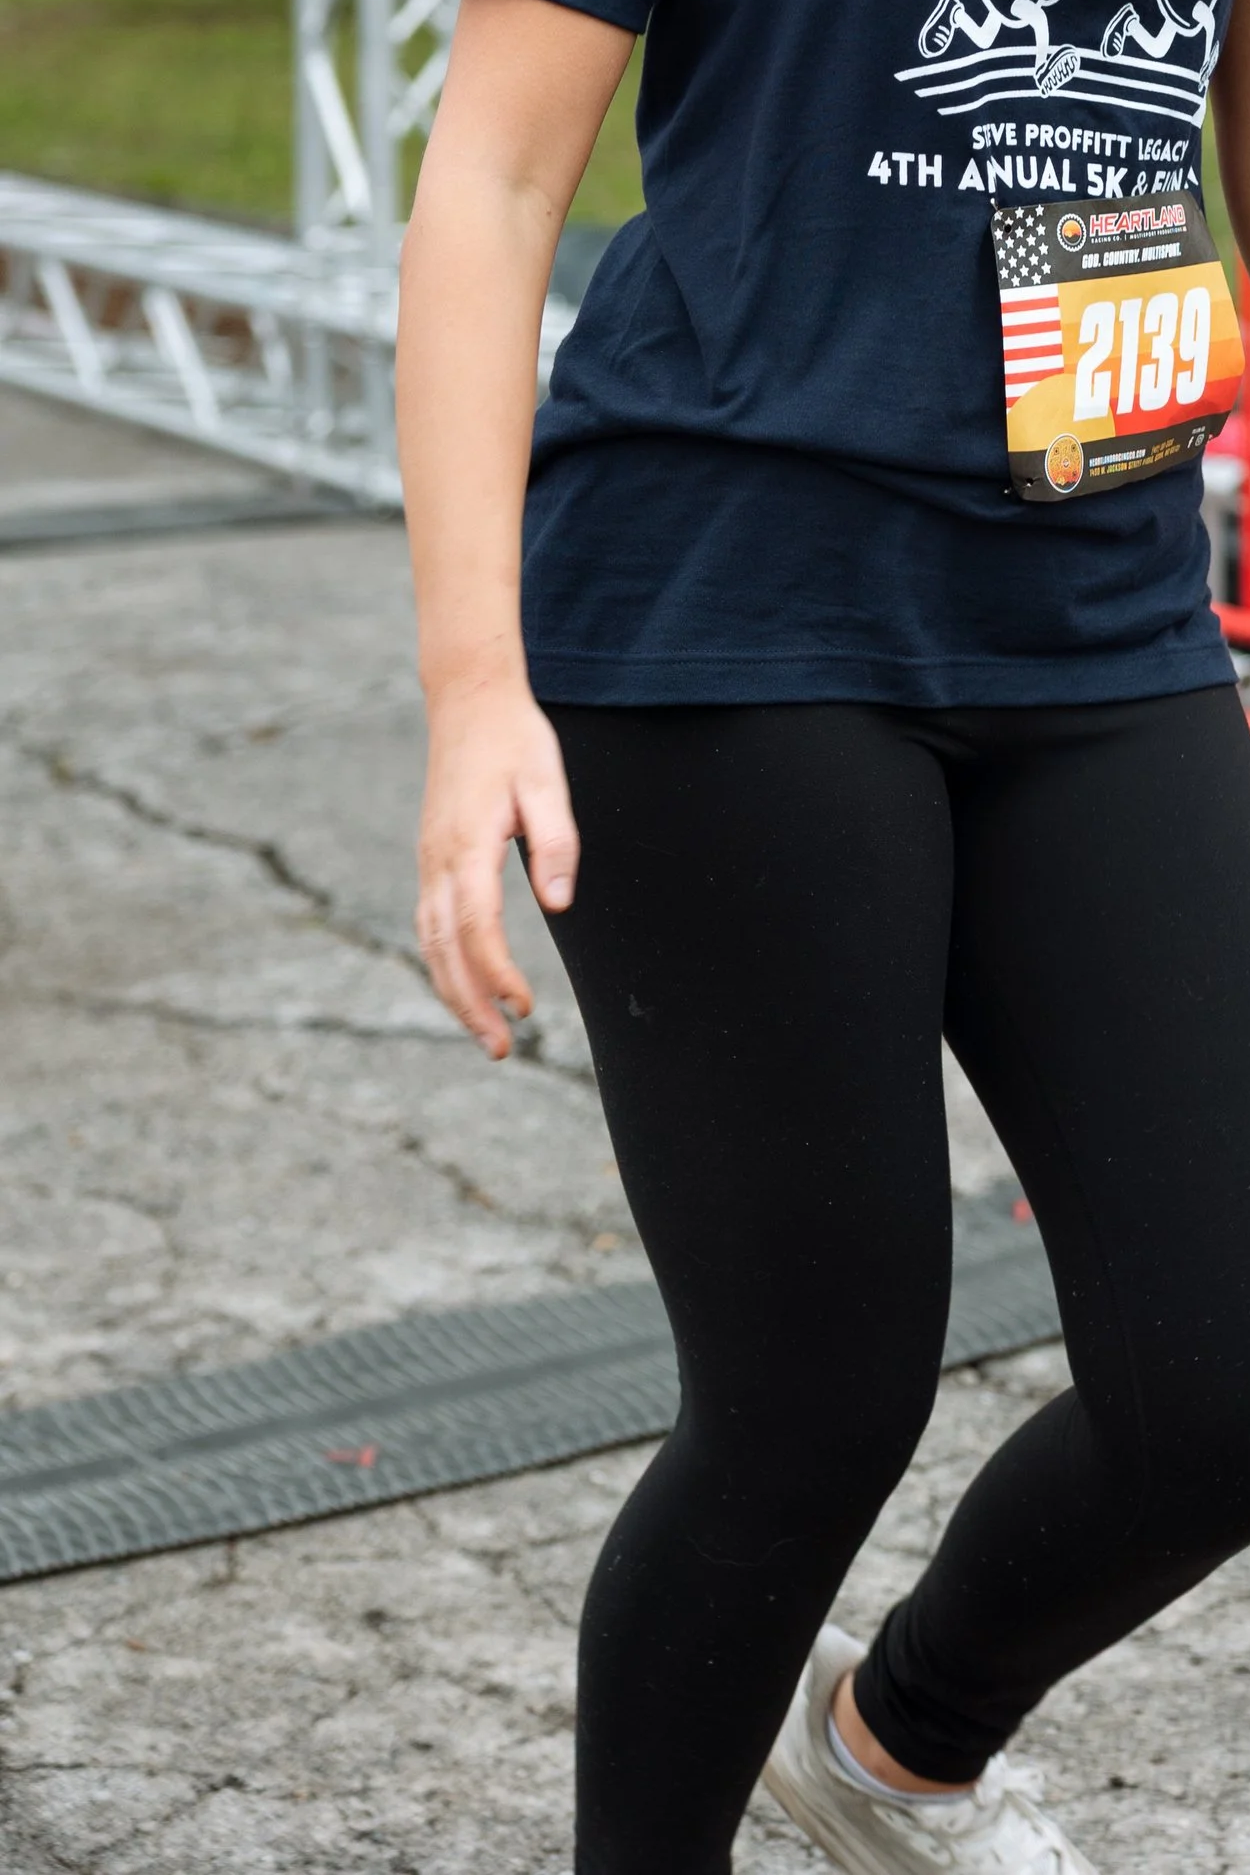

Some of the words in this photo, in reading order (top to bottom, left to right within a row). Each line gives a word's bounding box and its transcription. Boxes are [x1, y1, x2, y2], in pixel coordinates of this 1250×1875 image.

[1025, 123, 1132, 159] PROFFITT
[1138, 137, 1190, 162] LEGACY
[867, 151, 943, 188] 4TH
[1086, 162, 1128, 199] 5K
[1131, 170, 1149, 197] &
[1089, 204, 1187, 238] HEARTLAND
[1082, 252, 1101, 270] GOD.
[1103, 248, 1140, 267] COUNTRY.
[1141, 242, 1182, 262] MULTISPORT.
[1073, 286, 1211, 422] 2139
